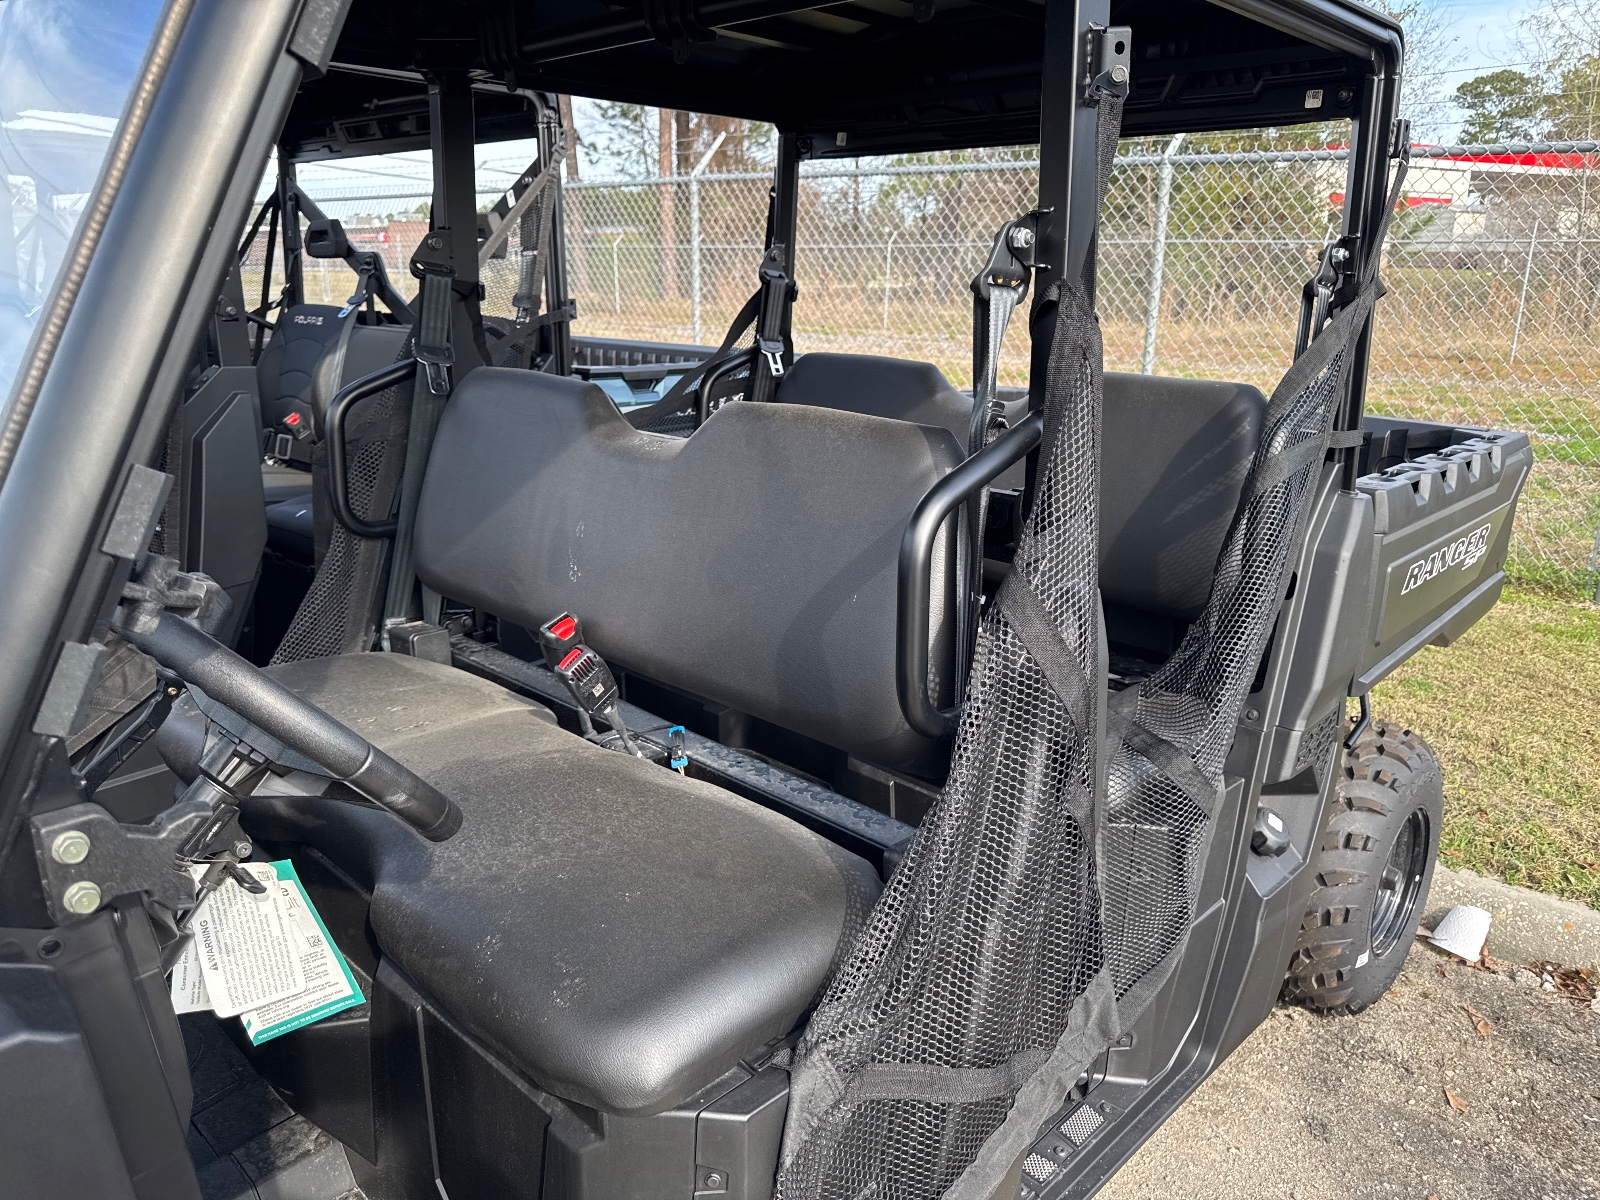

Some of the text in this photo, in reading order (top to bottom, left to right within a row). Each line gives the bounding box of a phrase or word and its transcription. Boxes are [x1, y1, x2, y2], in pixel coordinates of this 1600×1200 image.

[1400, 522, 1492, 596] RANGER
[1461, 545, 1488, 571] SP
[199, 922, 215, 966] WARNING
